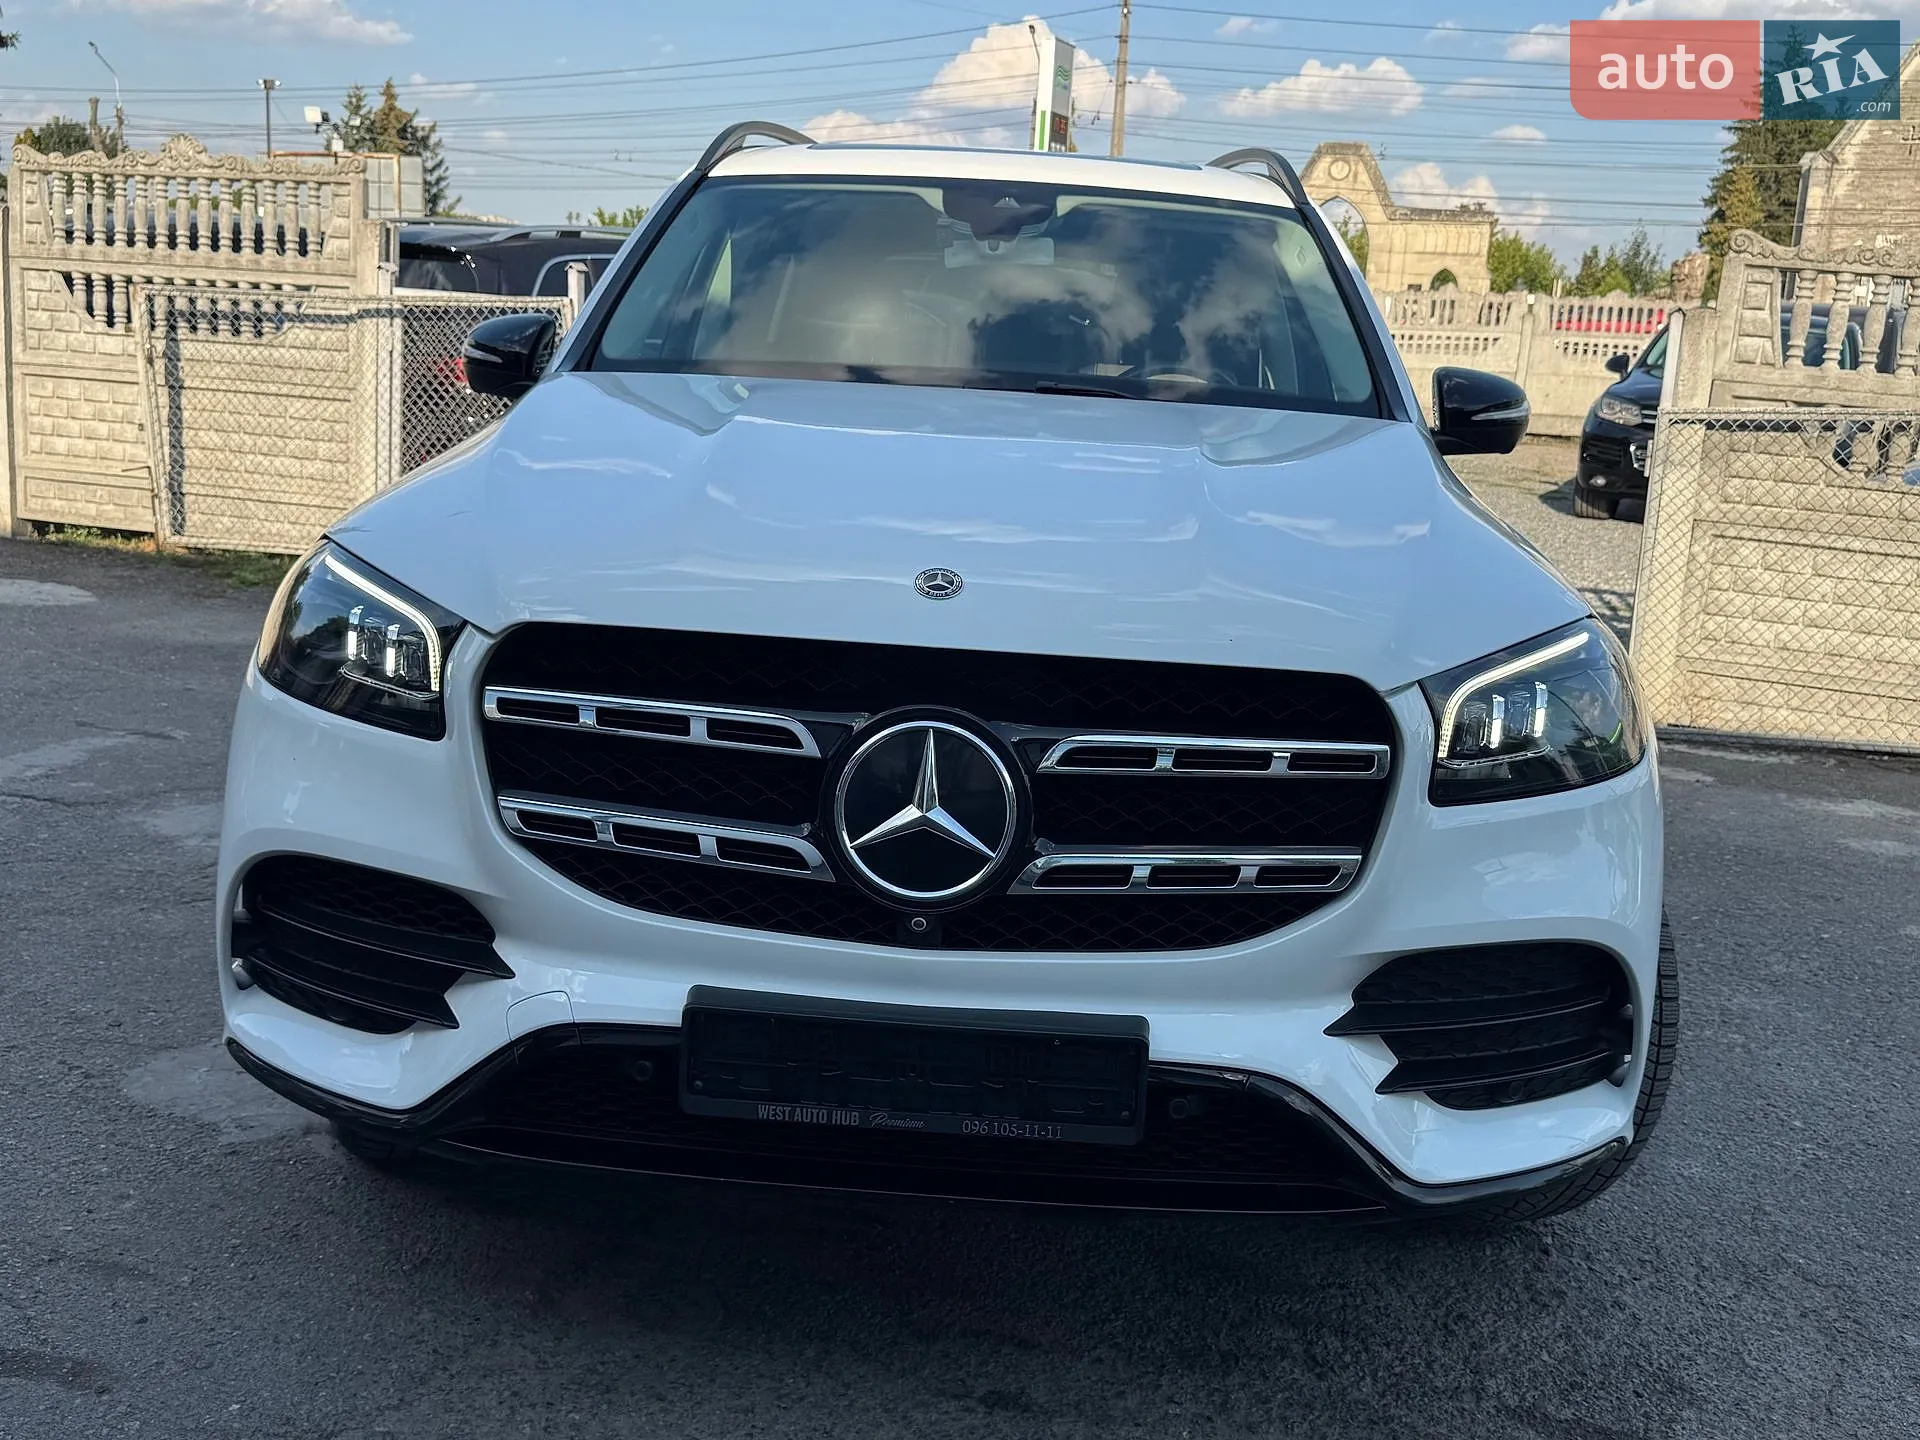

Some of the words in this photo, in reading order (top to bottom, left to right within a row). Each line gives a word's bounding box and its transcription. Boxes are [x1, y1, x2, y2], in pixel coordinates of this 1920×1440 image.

[758, 1104, 791, 1120] WEST
[794, 1107, 827, 1124] AUTO
[831, 1110, 860, 1126] HUB
[869, 1112, 925, 1129] Premium
[962, 1120, 989, 1135] 096
[993, 1122, 1064, 1139] 105-11-11
